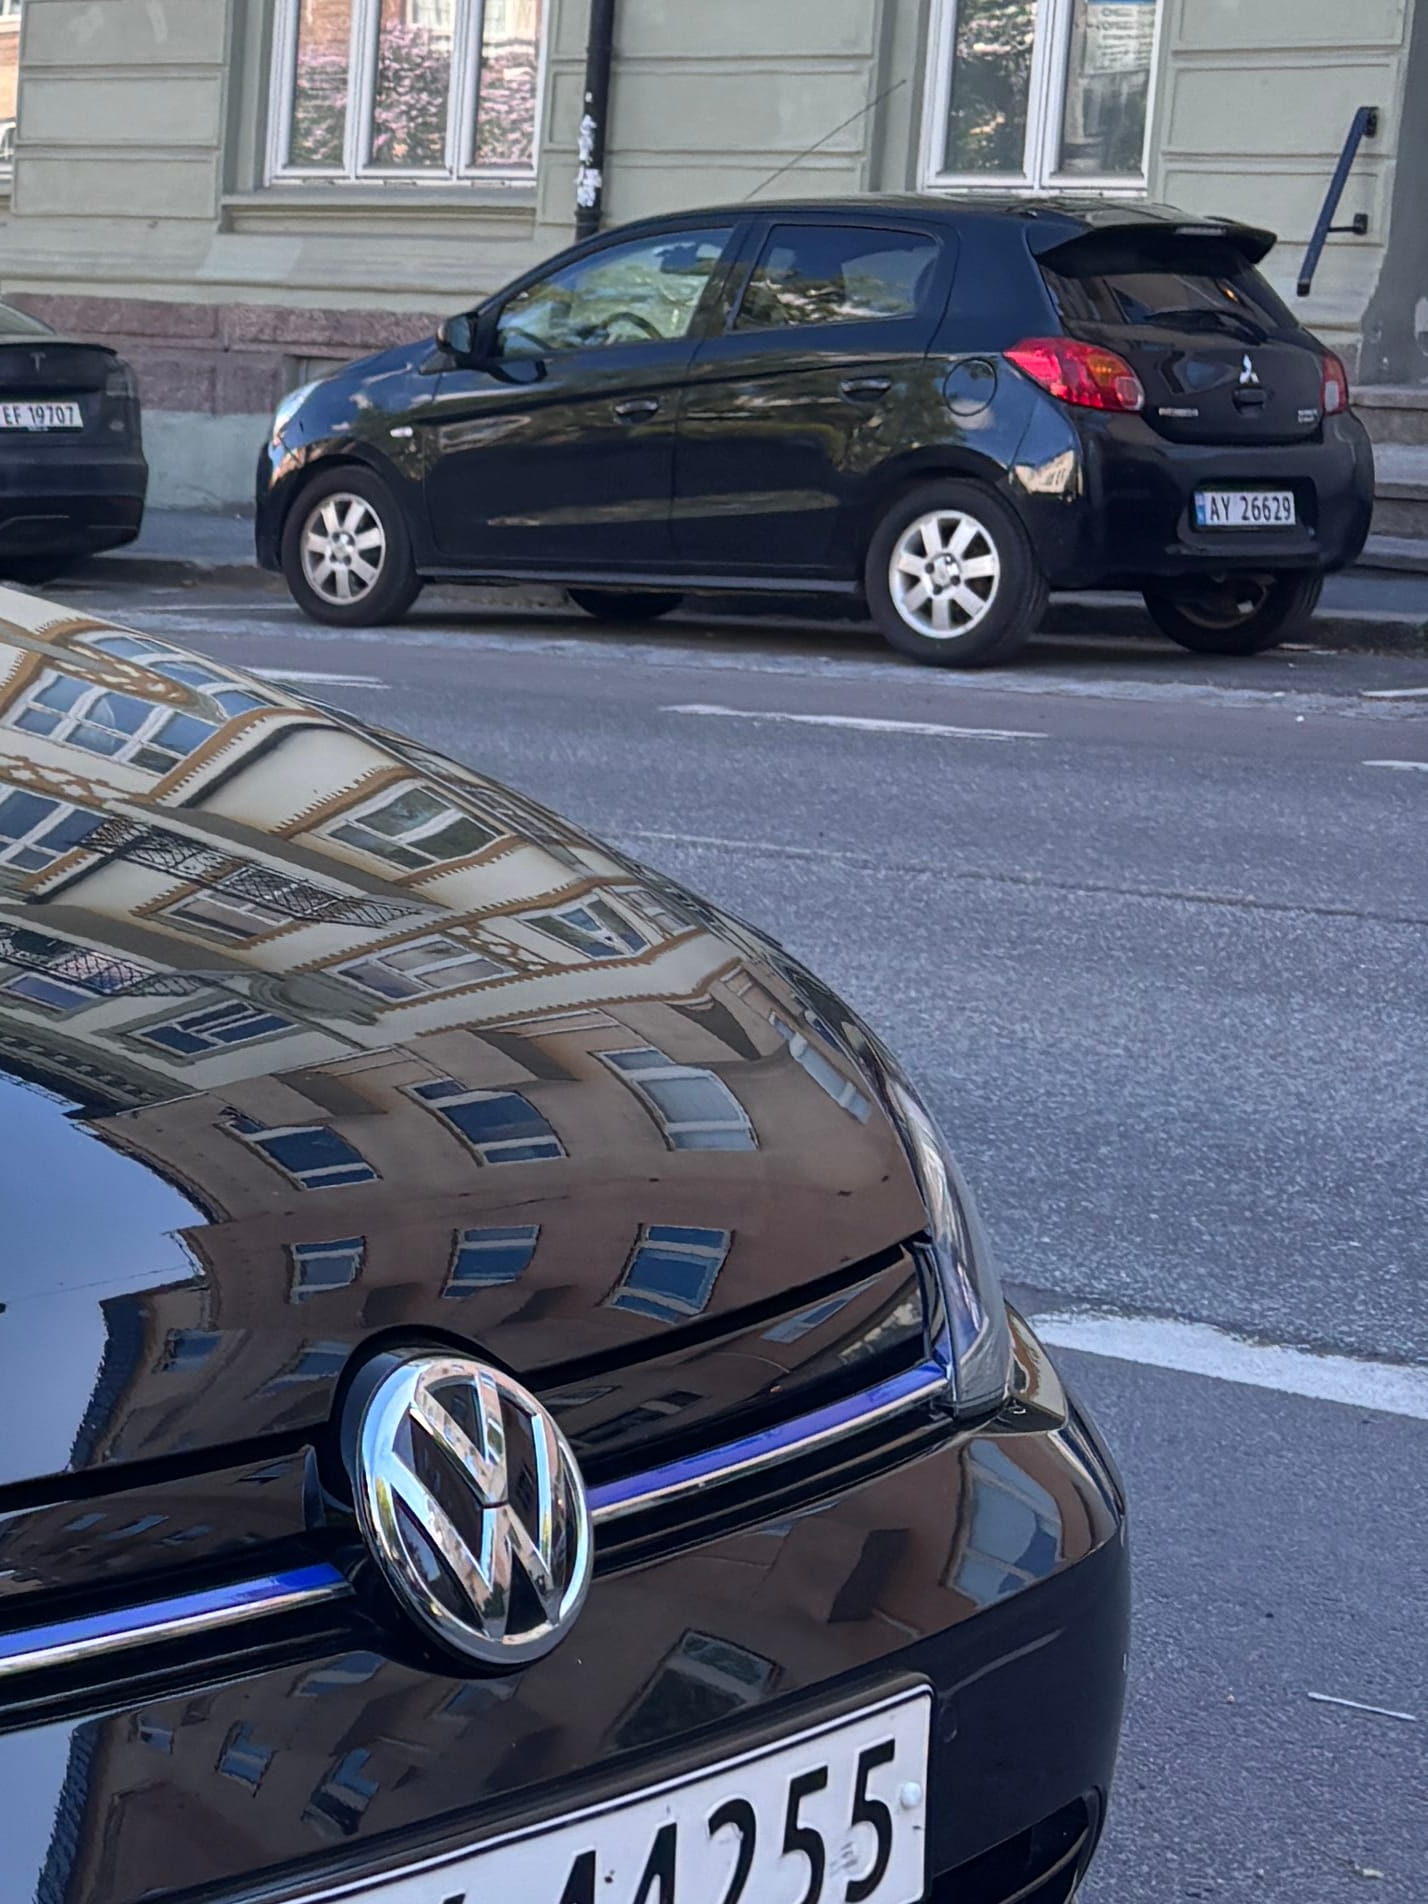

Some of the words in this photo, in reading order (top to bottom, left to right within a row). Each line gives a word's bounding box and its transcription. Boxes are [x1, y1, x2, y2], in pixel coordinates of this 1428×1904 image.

[2, 405, 22, 425] EF
[26, 405, 75, 425] 19707
[1210, 495, 1231, 522] AY
[1240, 495, 1292, 522] 26629
